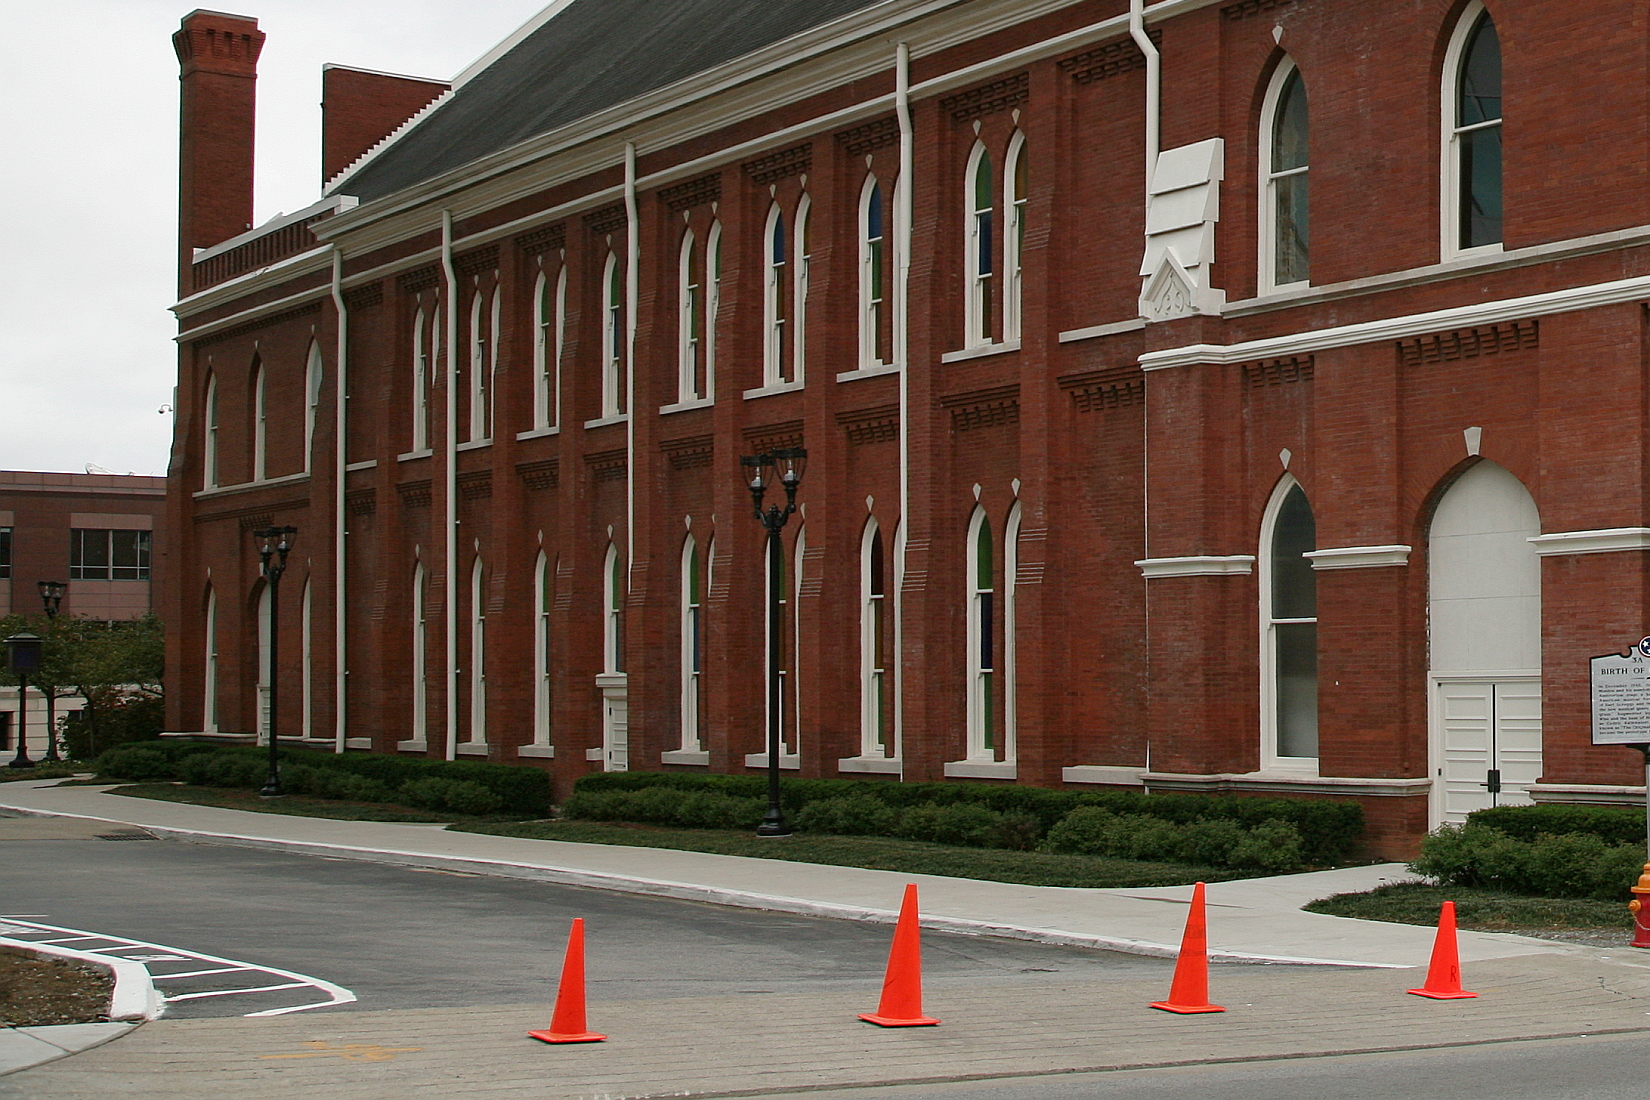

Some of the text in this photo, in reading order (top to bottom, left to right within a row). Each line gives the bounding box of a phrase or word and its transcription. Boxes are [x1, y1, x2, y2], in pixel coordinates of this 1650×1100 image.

[1631, 656, 1643, 664] 3A
[1601, 667, 1628, 675] BIRTH
[1632, 666, 1645, 674] OF
[1450, 965, 1457, 983] R
